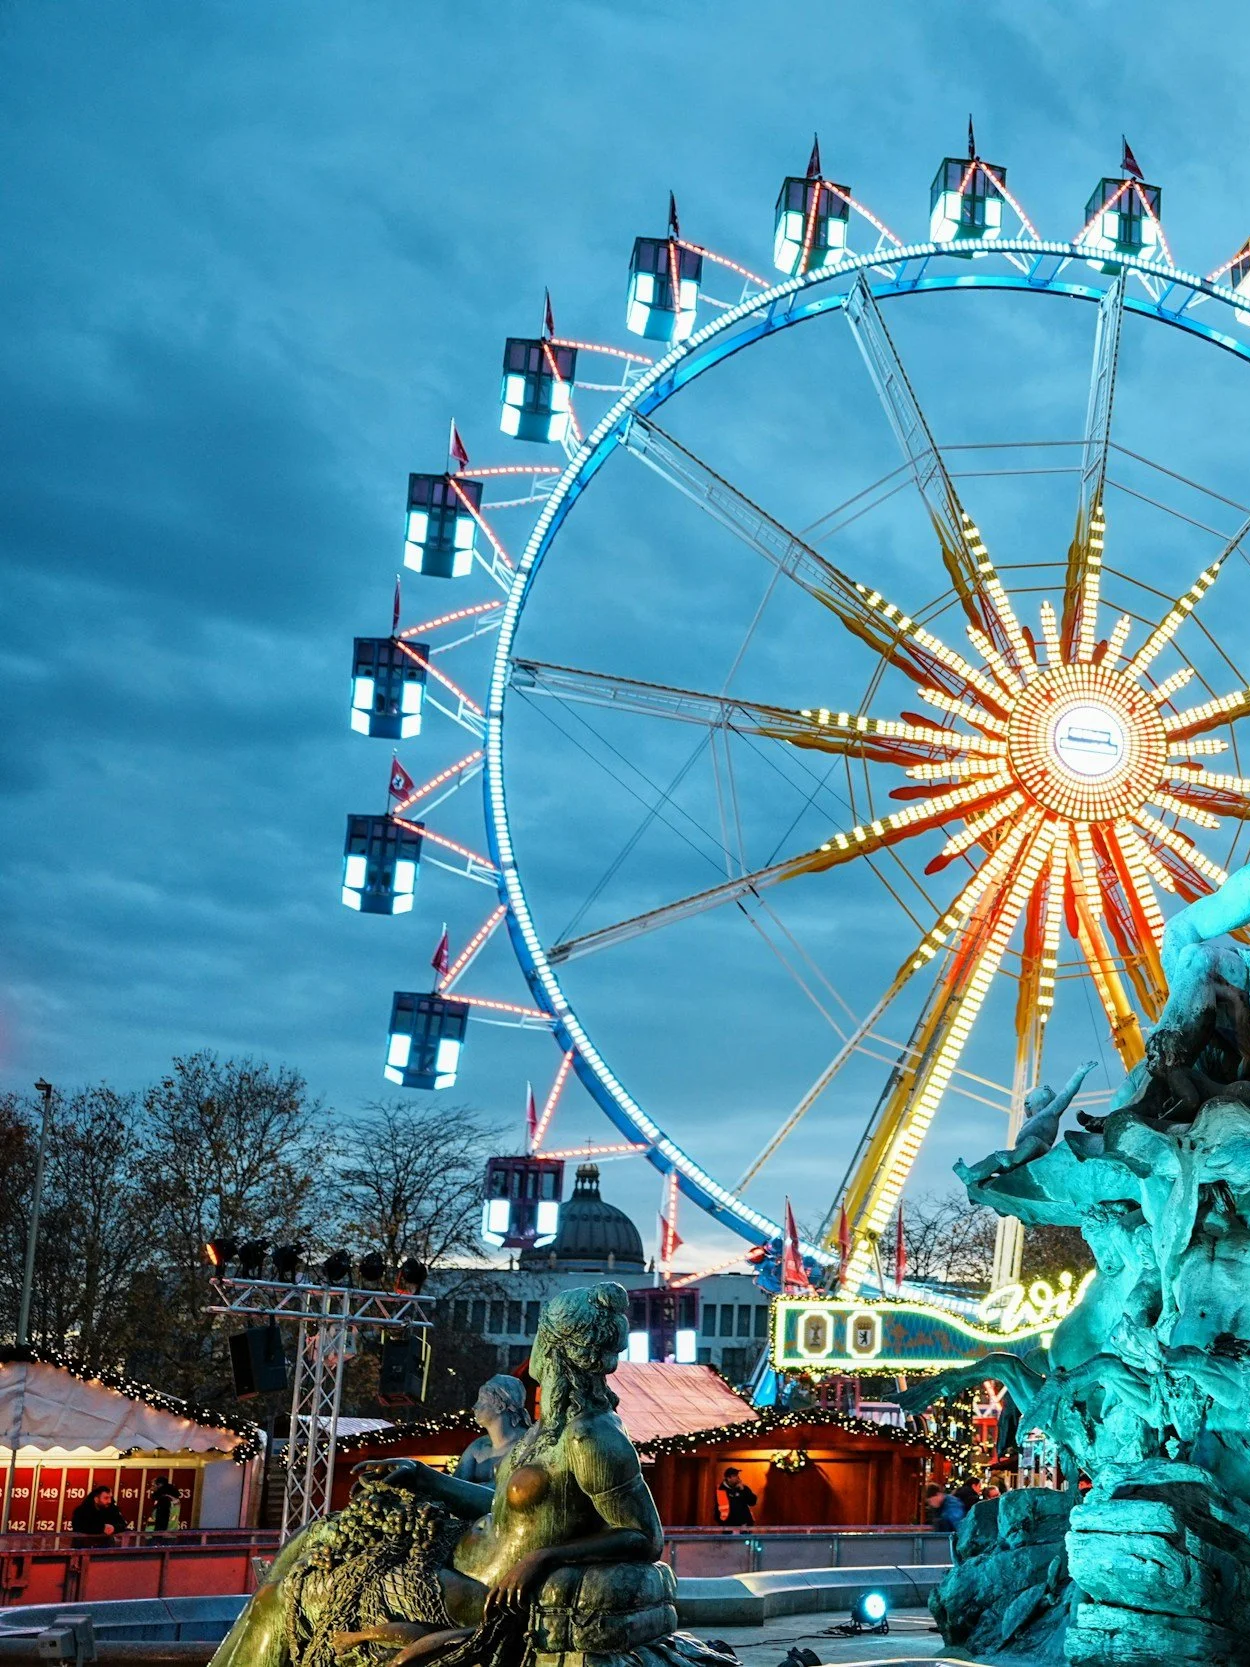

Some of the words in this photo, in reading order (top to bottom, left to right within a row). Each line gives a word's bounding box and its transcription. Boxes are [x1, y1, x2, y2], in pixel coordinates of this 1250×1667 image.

[11, 1487, 29, 1498] 139
[39, 1487, 59, 1498] 149
[66, 1487, 86, 1499] 150
[120, 1488, 139, 1499] 161
[178, 1488, 191, 1499] 63
[8, 1520, 27, 1531] 142
[36, 1520, 55, 1531] 152
[62, 1520, 74, 1531] 15
